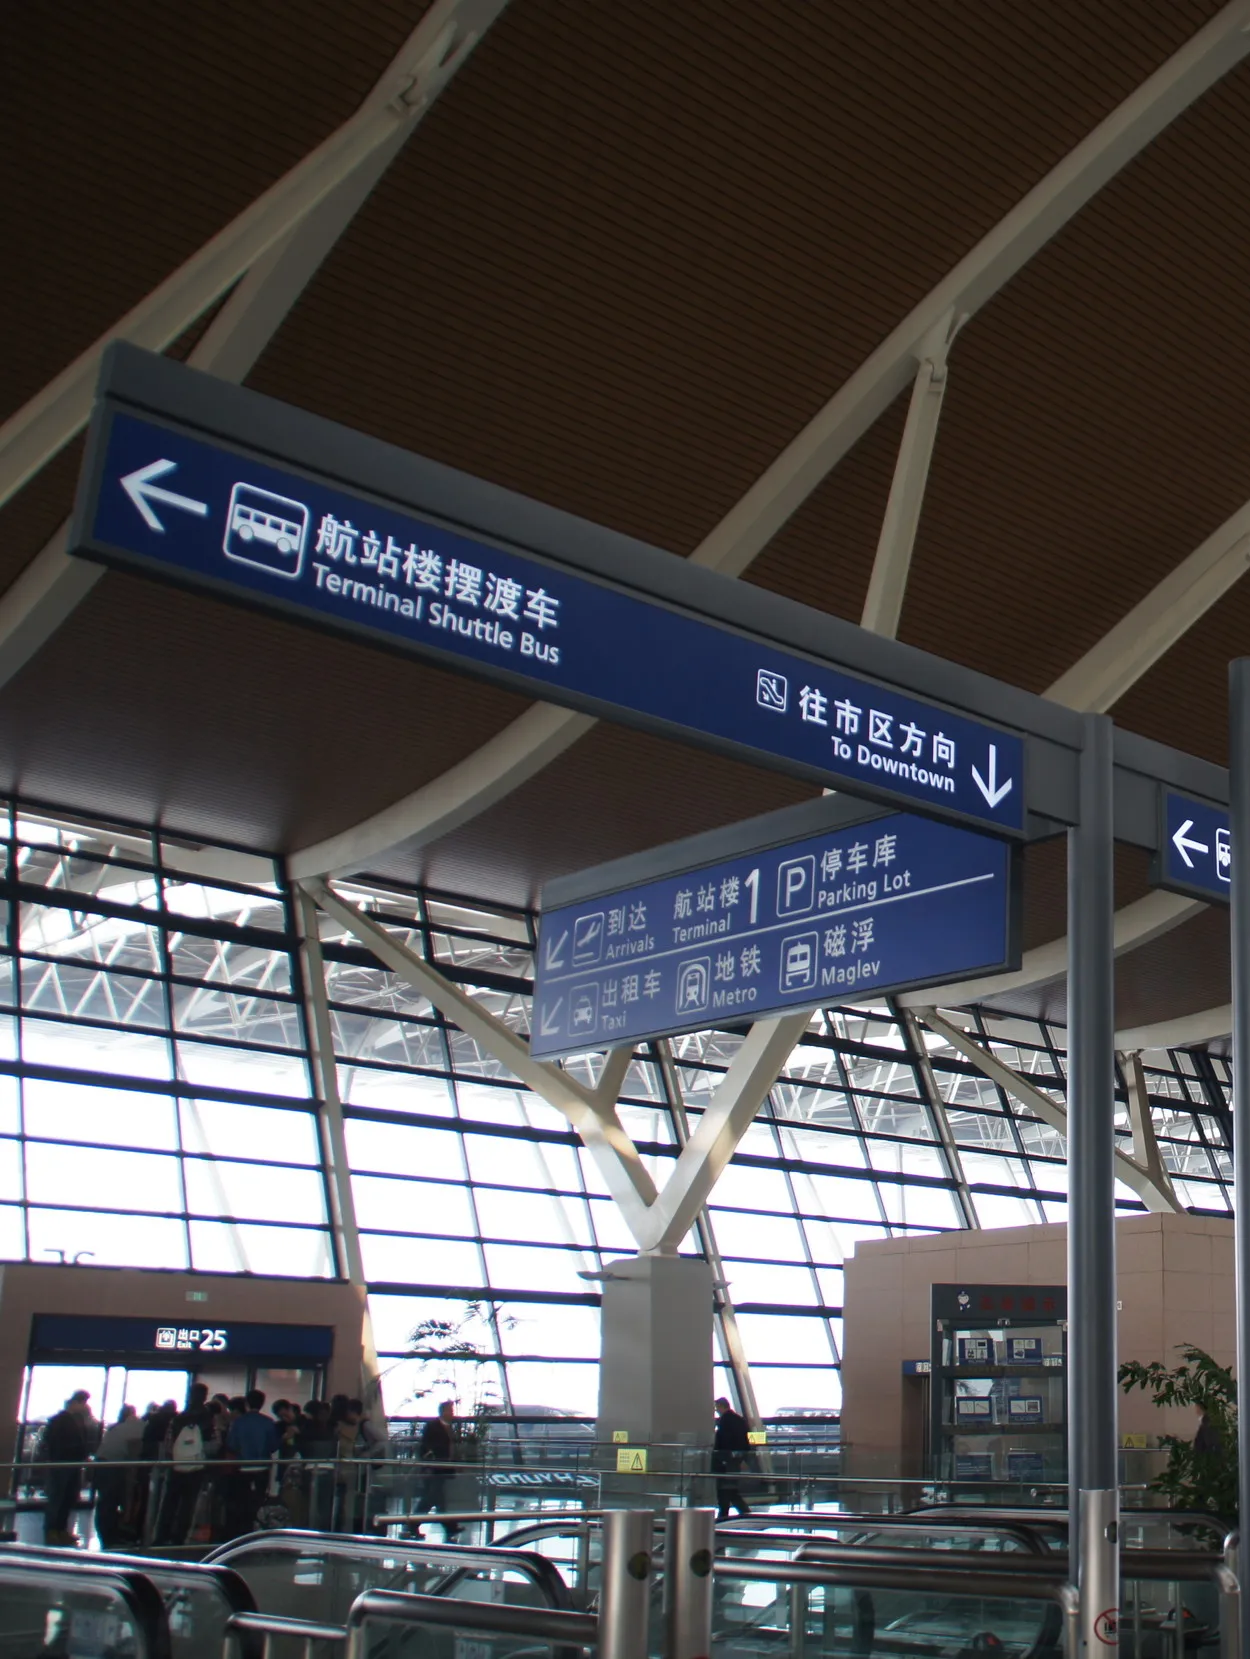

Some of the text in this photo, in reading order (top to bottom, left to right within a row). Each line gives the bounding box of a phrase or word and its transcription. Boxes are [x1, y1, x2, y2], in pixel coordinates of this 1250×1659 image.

[315, 513, 560, 629] 航站楼摆渡车
[312, 562, 561, 666] Terminal Shuttle Bus
[798, 685, 955, 769] 往市区方向
[831, 735, 955, 793] To Downtown
[820, 833, 897, 883] 停车库
[673, 868, 760, 924] 航站楼 1
[785, 866, 806, 907] P
[818, 870, 911, 909] Parking Lot
[607, 901, 647, 936] 到达
[672, 913, 731, 944] Terminal
[823, 917, 875, 958] 磁浮
[605, 934, 655, 960] Arrivals
[714, 944, 761, 982] 地铁
[602, 969, 661, 1007] 出租车
[821, 959, 881, 986] Maglev
[712, 985, 757, 1008] Metro
[602, 1011, 626, 1031] Taxi
[178, 1328, 226, 1350] 出口 25
